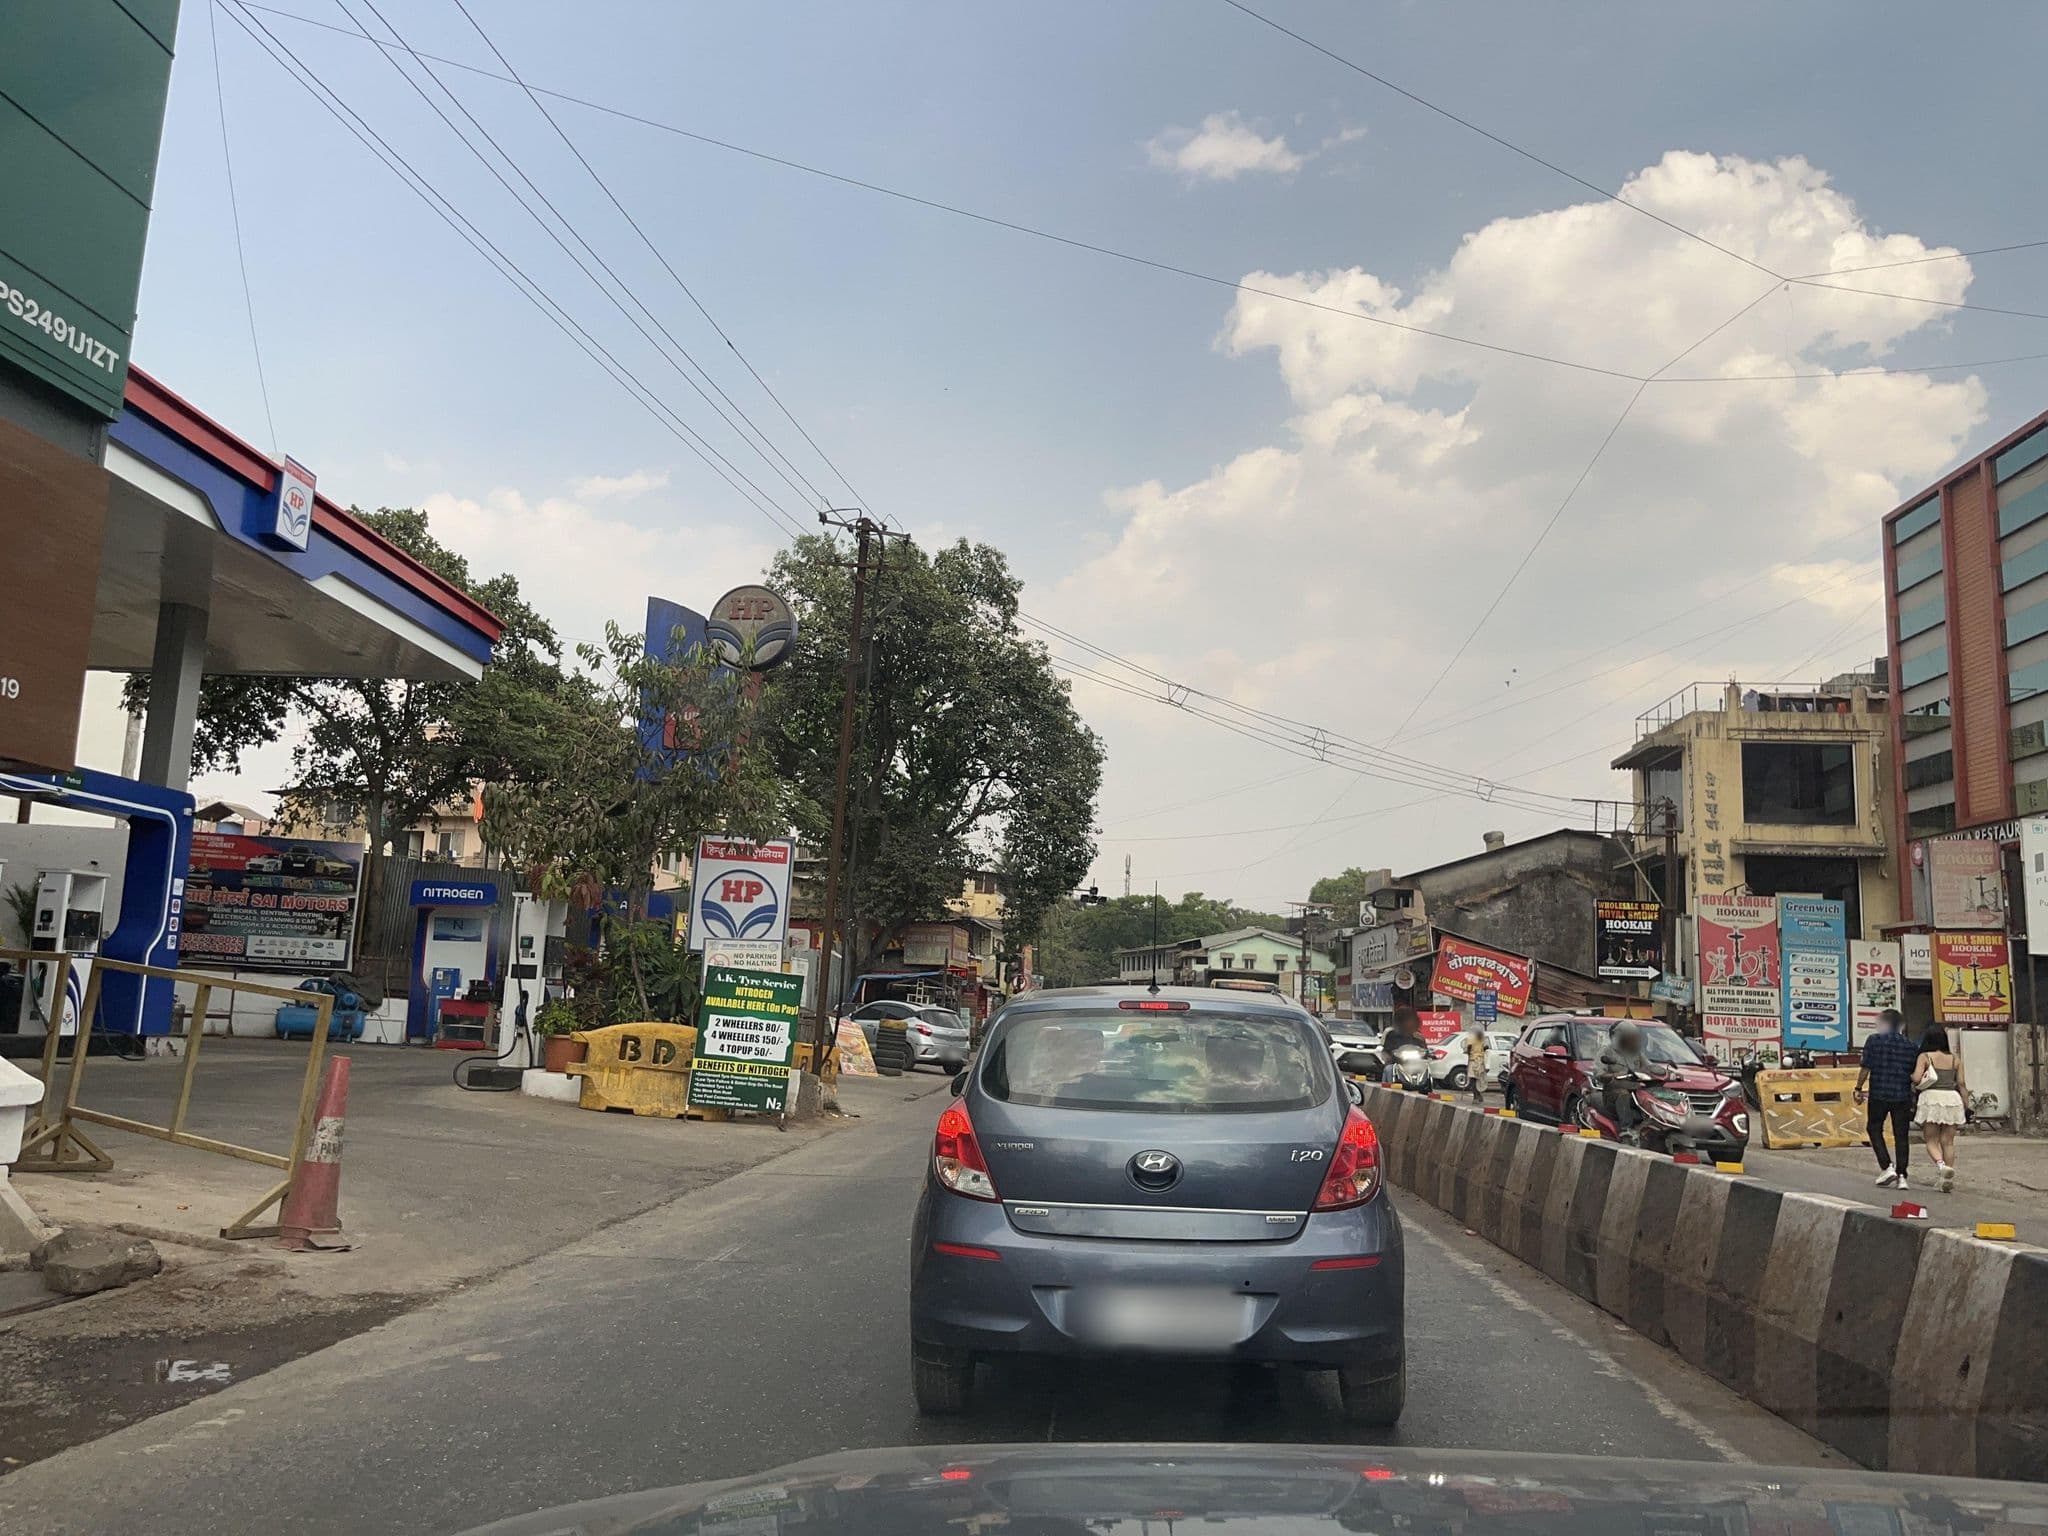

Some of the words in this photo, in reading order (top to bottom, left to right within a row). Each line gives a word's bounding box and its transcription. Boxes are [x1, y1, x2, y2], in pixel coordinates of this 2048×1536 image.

[0, 281, 119, 373] PS2491J1ZT
[290, 492, 304, 510] HP
[729, 598, 774, 620] HP
[0, 677, 20, 698] 19
[423, 888, 484, 899] NITROGEN
[721, 880, 763, 903] HP
[251, 893, 278, 909] SAI
[281, 895, 349, 912] MOTORS
[1598, 902, 1638, 910] WHOLESALE
[1641, 903, 1660, 911] SHOP
[1702, 895, 1734, 906] ROYAL
[1736, 896, 1773, 908] SMOKE
[1786, 901, 1840, 914] Greenwich
[1598, 910, 1626, 919] ROYAL
[1628, 911, 1659, 920] SMOKE
[1717, 908, 1759, 917] HOOKAH
[1605, 920, 1652, 930] HOOKAH
[1940, 936, 1968, 945] ROYAL
[1970, 936, 2003, 946] SMOKE
[1952, 945, 1992, 953] HOOKAH
[1856, 962, 1895, 977] SPA
[715, 973, 737, 984] A.K.
[739, 975, 761, 987] Tyre
[762, 978, 798, 990] Service
[735, 987, 774, 1000] NITROGEN
[705, 996, 746, 1010] AVAILABLE
[746, 1000, 766, 1011] HERE
[767, 1002, 781, 1013] (On
[781, 1005, 799, 1016] Pay)
[1741, 998, 1771, 1006] AVAILABLE
[1706, 1016, 1739, 1026] ROYAL
[1740, 1018, 1778, 1028] SMOKE
[1944, 1014, 1988, 1022] WHOLESALE
[1989, 1014, 2010, 1022] SHOP
[715, 1018, 721, 1027] 2
[722, 1019, 763, 1031] WHEELERS
[765, 1023, 784, 1033] 80/-
[711, 1030, 717, 1039] 4
[718, 1031, 760, 1044] WHEELERS
[762, 1036, 784, 1046] 150/-
[719, 1043, 725, 1053] 4
[726, 1044, 753, 1055] TOPUP
[754, 1047, 773, 1057] 50/-
[697, 1060, 735, 1072] BENEFITS
[737, 1063, 748, 1073] OF
[748, 1064, 790, 1077] NITROGEN
[766, 1097, 781, 1110] N2
[1291, 1149, 1323, 1162] i20
